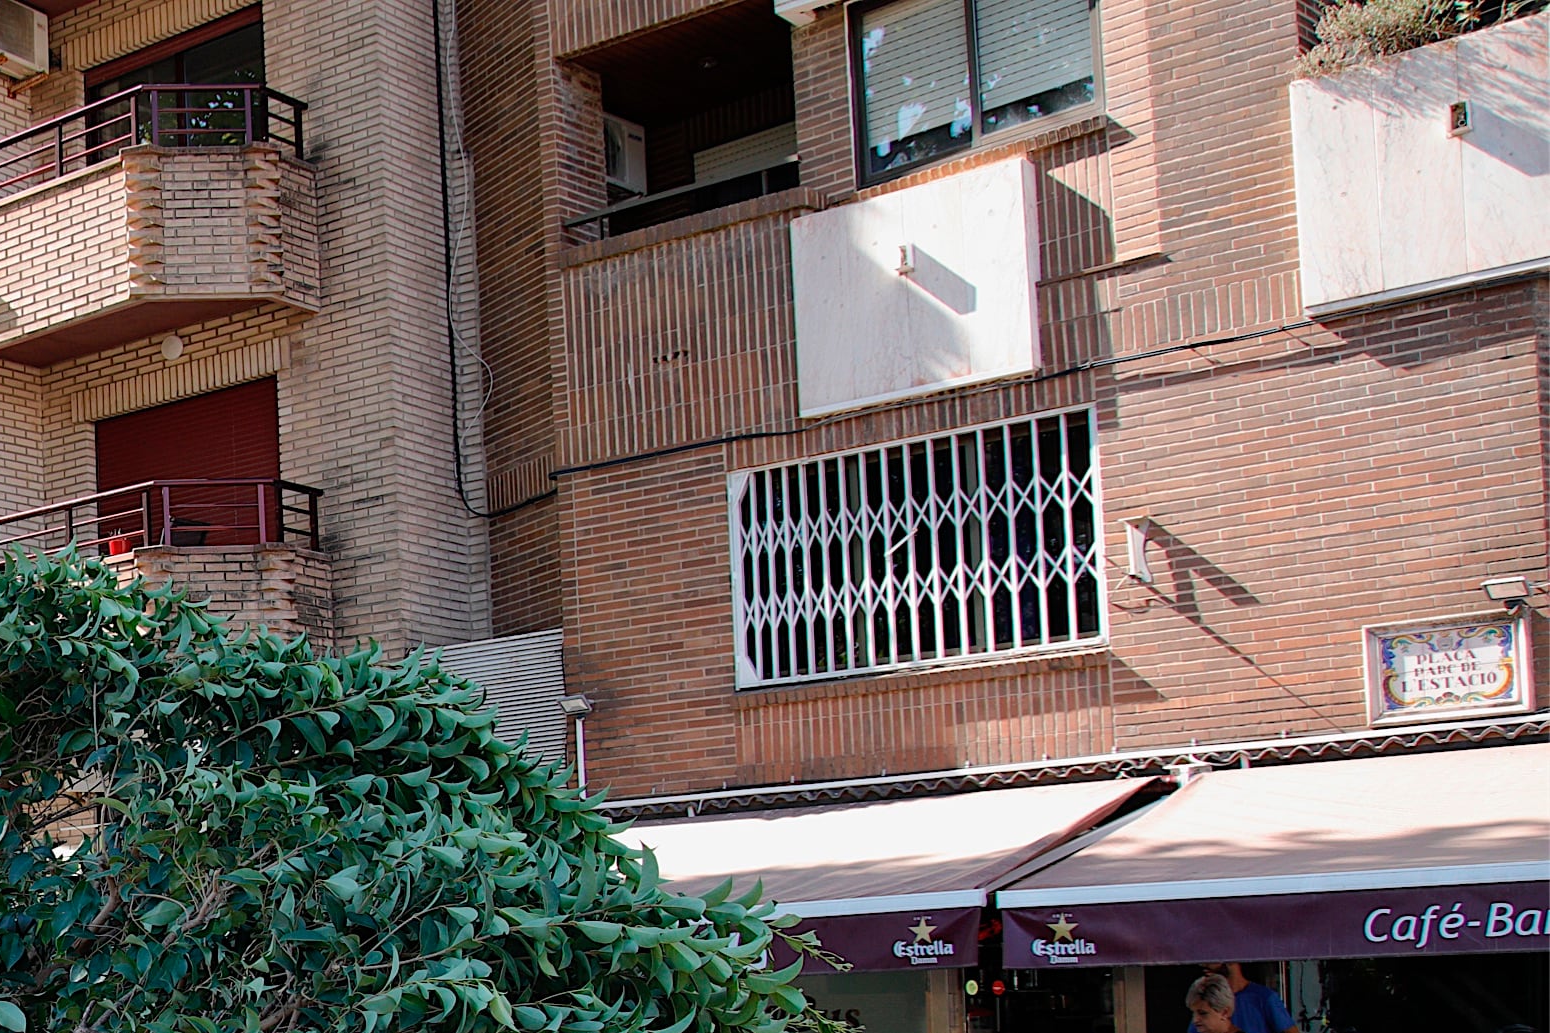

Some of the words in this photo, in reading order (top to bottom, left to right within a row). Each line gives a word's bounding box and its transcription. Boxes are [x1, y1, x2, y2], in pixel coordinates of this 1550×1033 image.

[1414, 664, 1456, 677] PARC
[1461, 661, 1481, 672] DE
[893, 939, 954, 957] Estrella
[1032, 938, 1096, 957] Estrella
